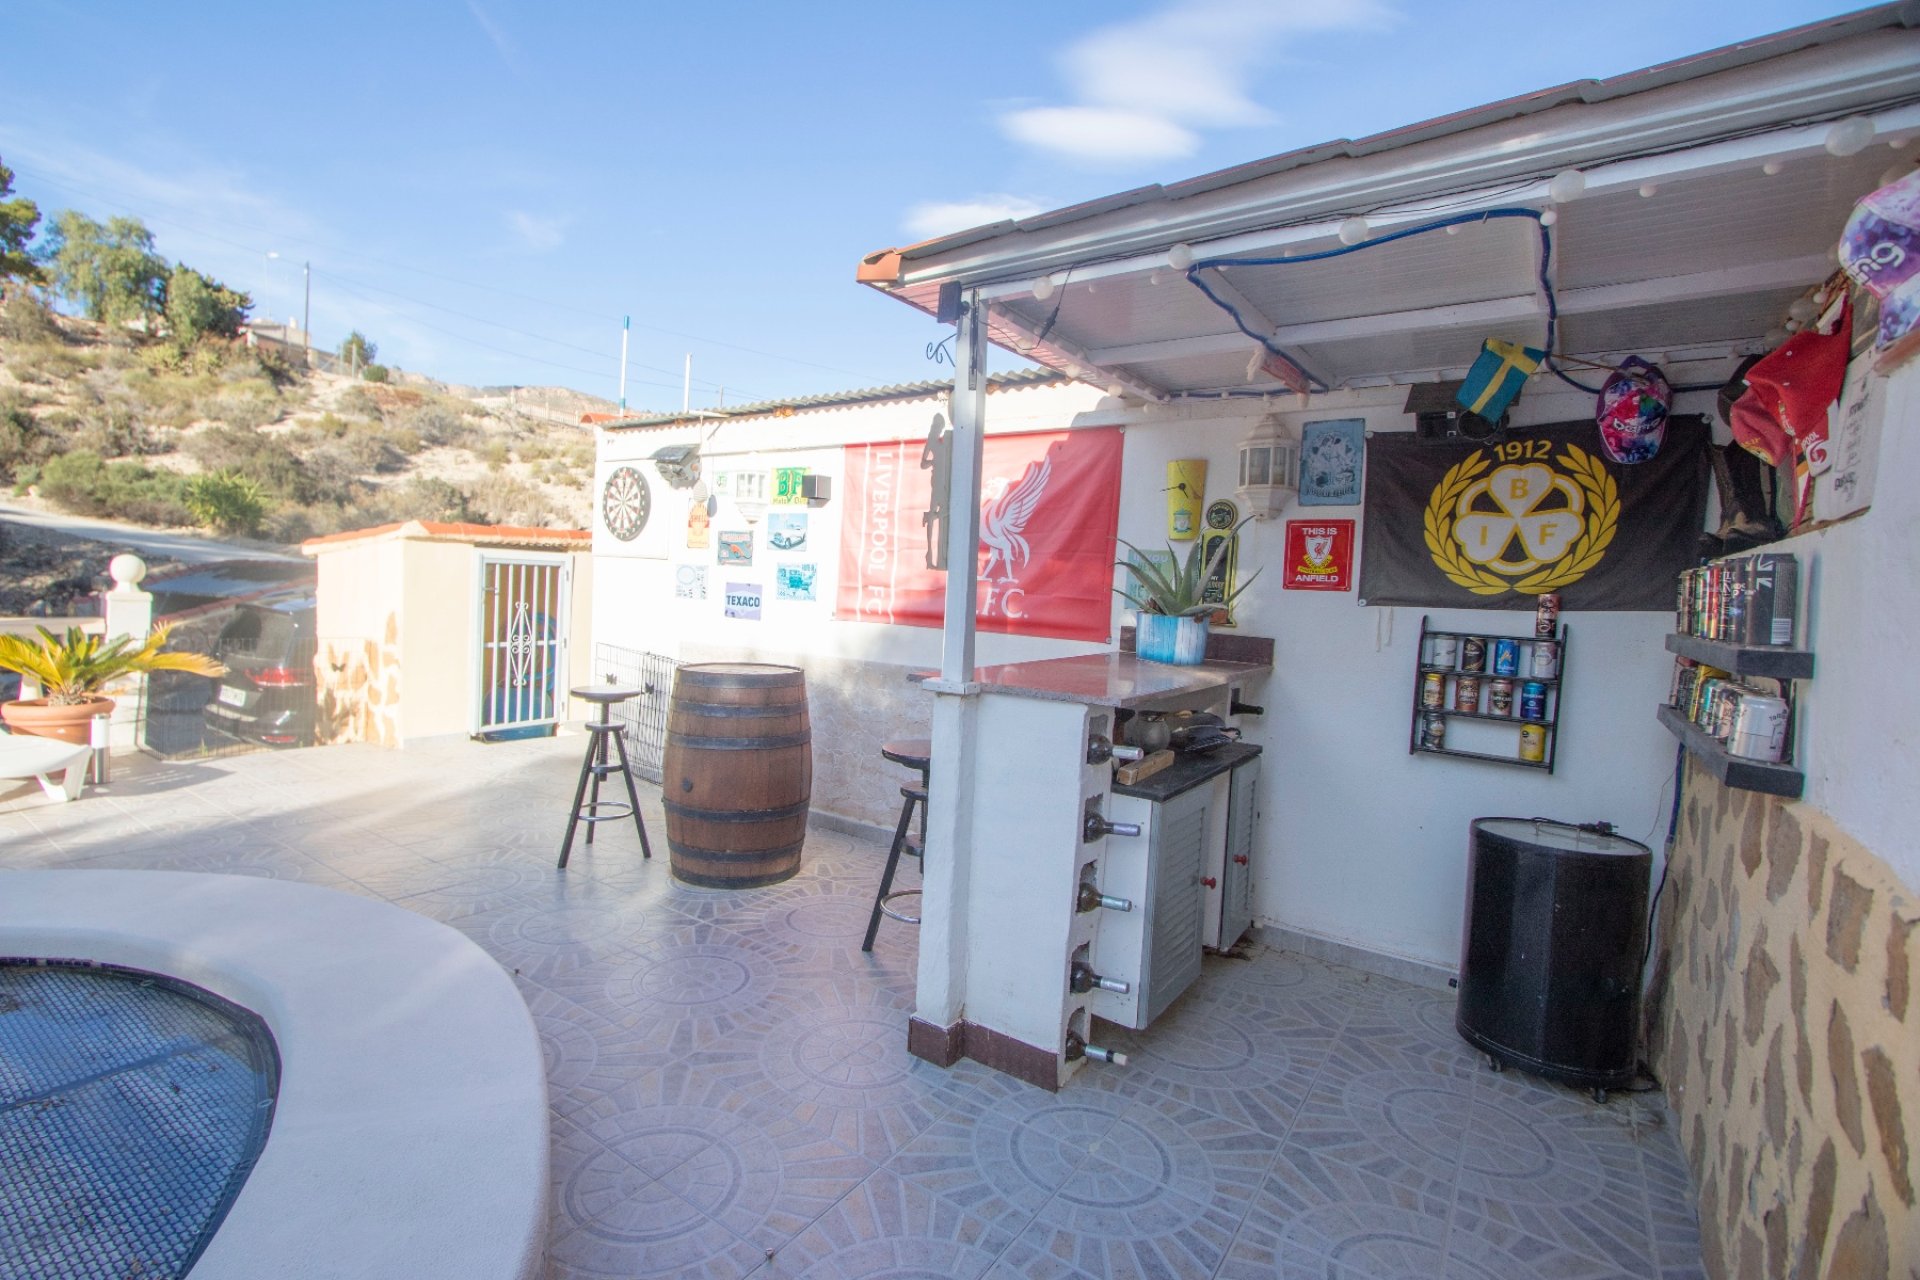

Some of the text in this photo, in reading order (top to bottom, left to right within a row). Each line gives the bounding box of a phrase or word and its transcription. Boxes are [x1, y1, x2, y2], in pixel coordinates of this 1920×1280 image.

[1493, 440, 1553, 461] 1912
[1510, 478, 1529, 499] B
[868, 452, 892, 574] LIVERPOOL
[1302, 527, 1338, 535] THIS IS
[1480, 523, 1558, 546] I F
[1295, 574, 1339, 583] ANFIELD
[726, 595, 760, 607] TEXACO
[865, 584, 885, 615] FC
[976, 588, 1029, 619] .F.C.
